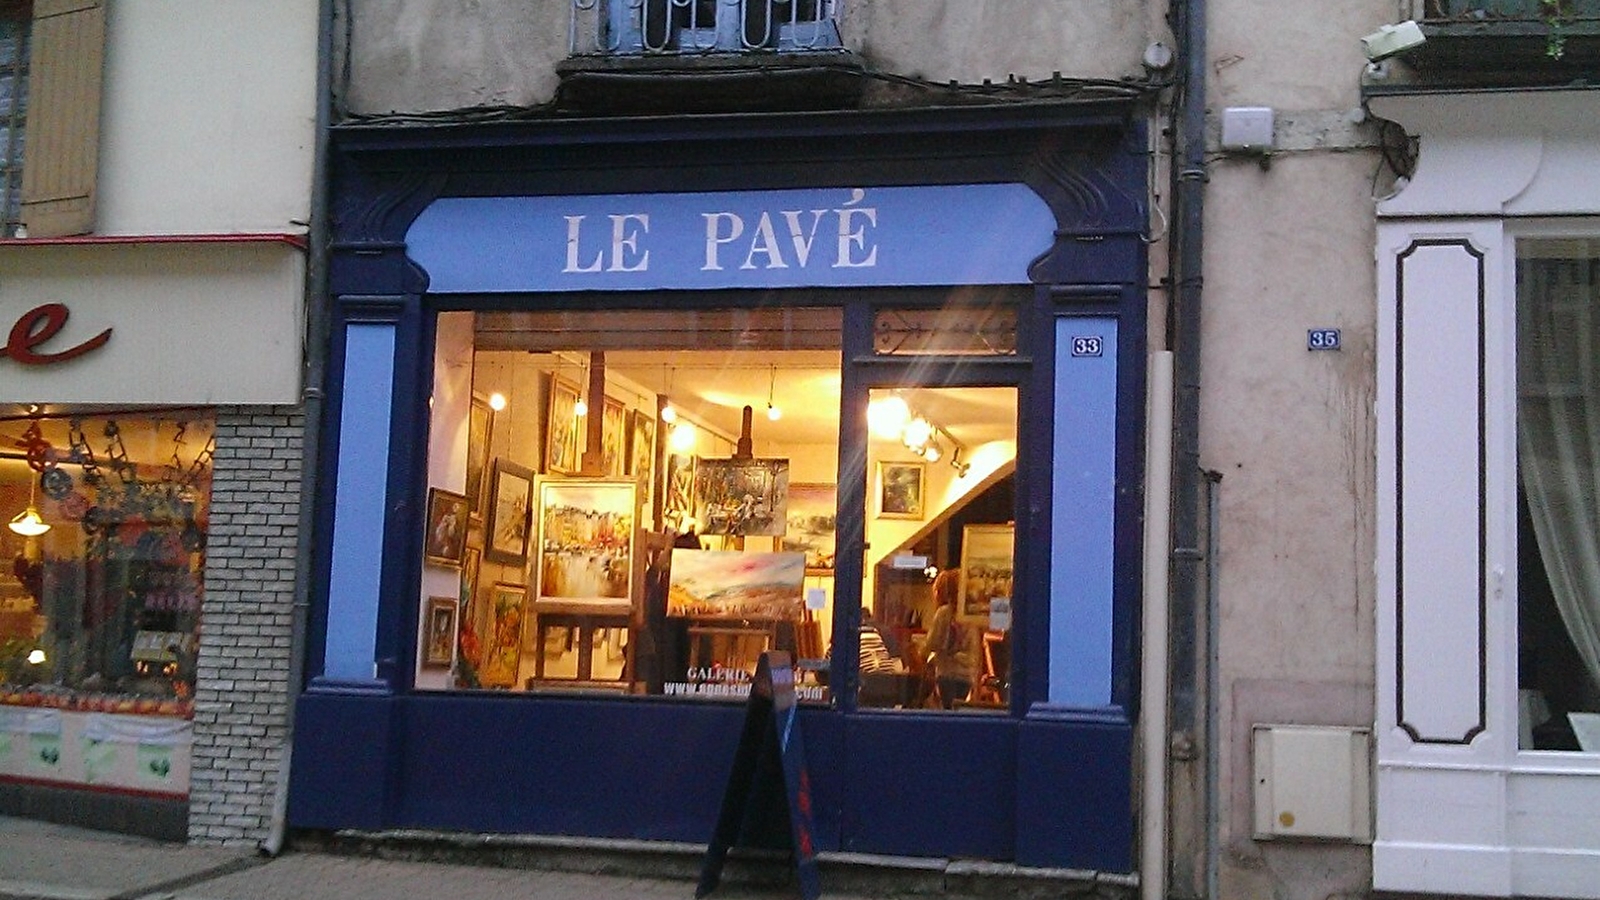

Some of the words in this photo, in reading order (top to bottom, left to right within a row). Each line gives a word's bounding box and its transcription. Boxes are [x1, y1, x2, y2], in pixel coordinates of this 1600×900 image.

[562, 213, 650, 274] LE
[700, 187, 878, 272] PAVÉ
[1076, 339, 1099, 353] 33
[1312, 331, 1336, 347] 35
[687, 666, 750, 682] GALERIE
